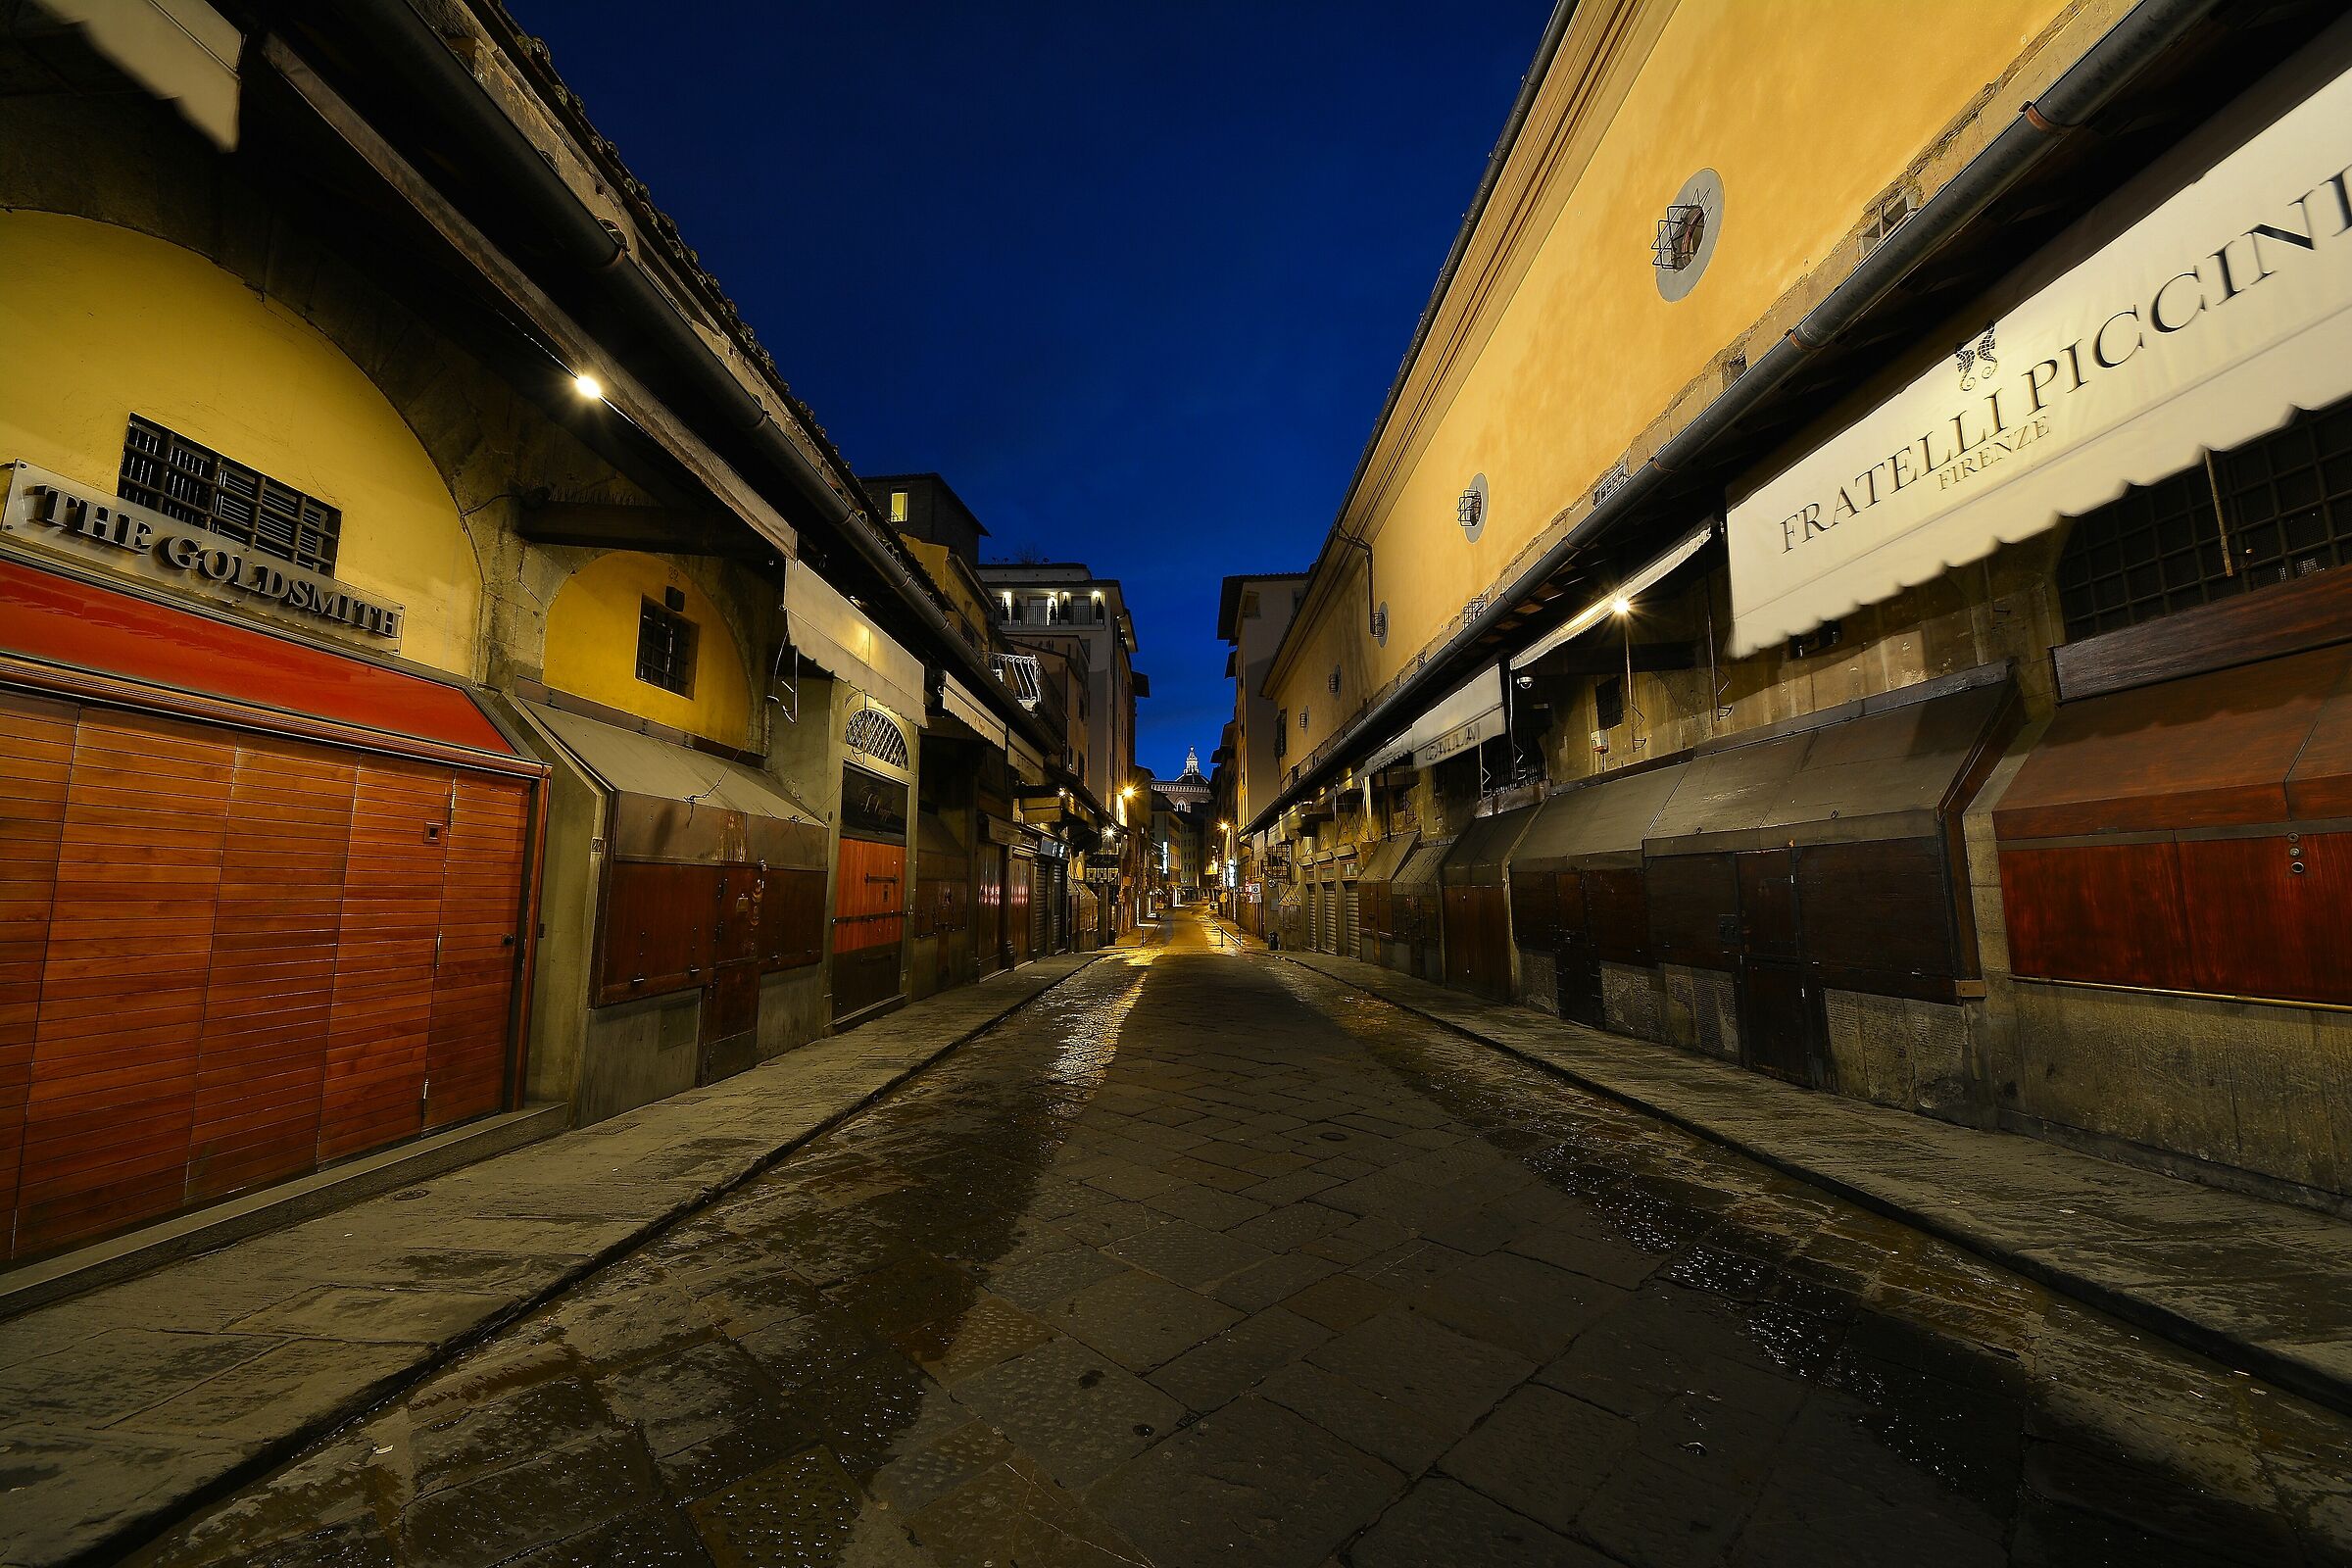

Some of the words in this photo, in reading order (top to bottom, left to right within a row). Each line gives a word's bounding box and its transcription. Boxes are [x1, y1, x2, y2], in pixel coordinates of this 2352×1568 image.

[1780, 388, 2008, 554] FRATELLI
[2021, 164, 2352, 416] PICCINI
[1937, 415, 2051, 491] FIRENZE
[35, 484, 153, 555] THE
[160, 534, 401, 639] GOLDSMITH
